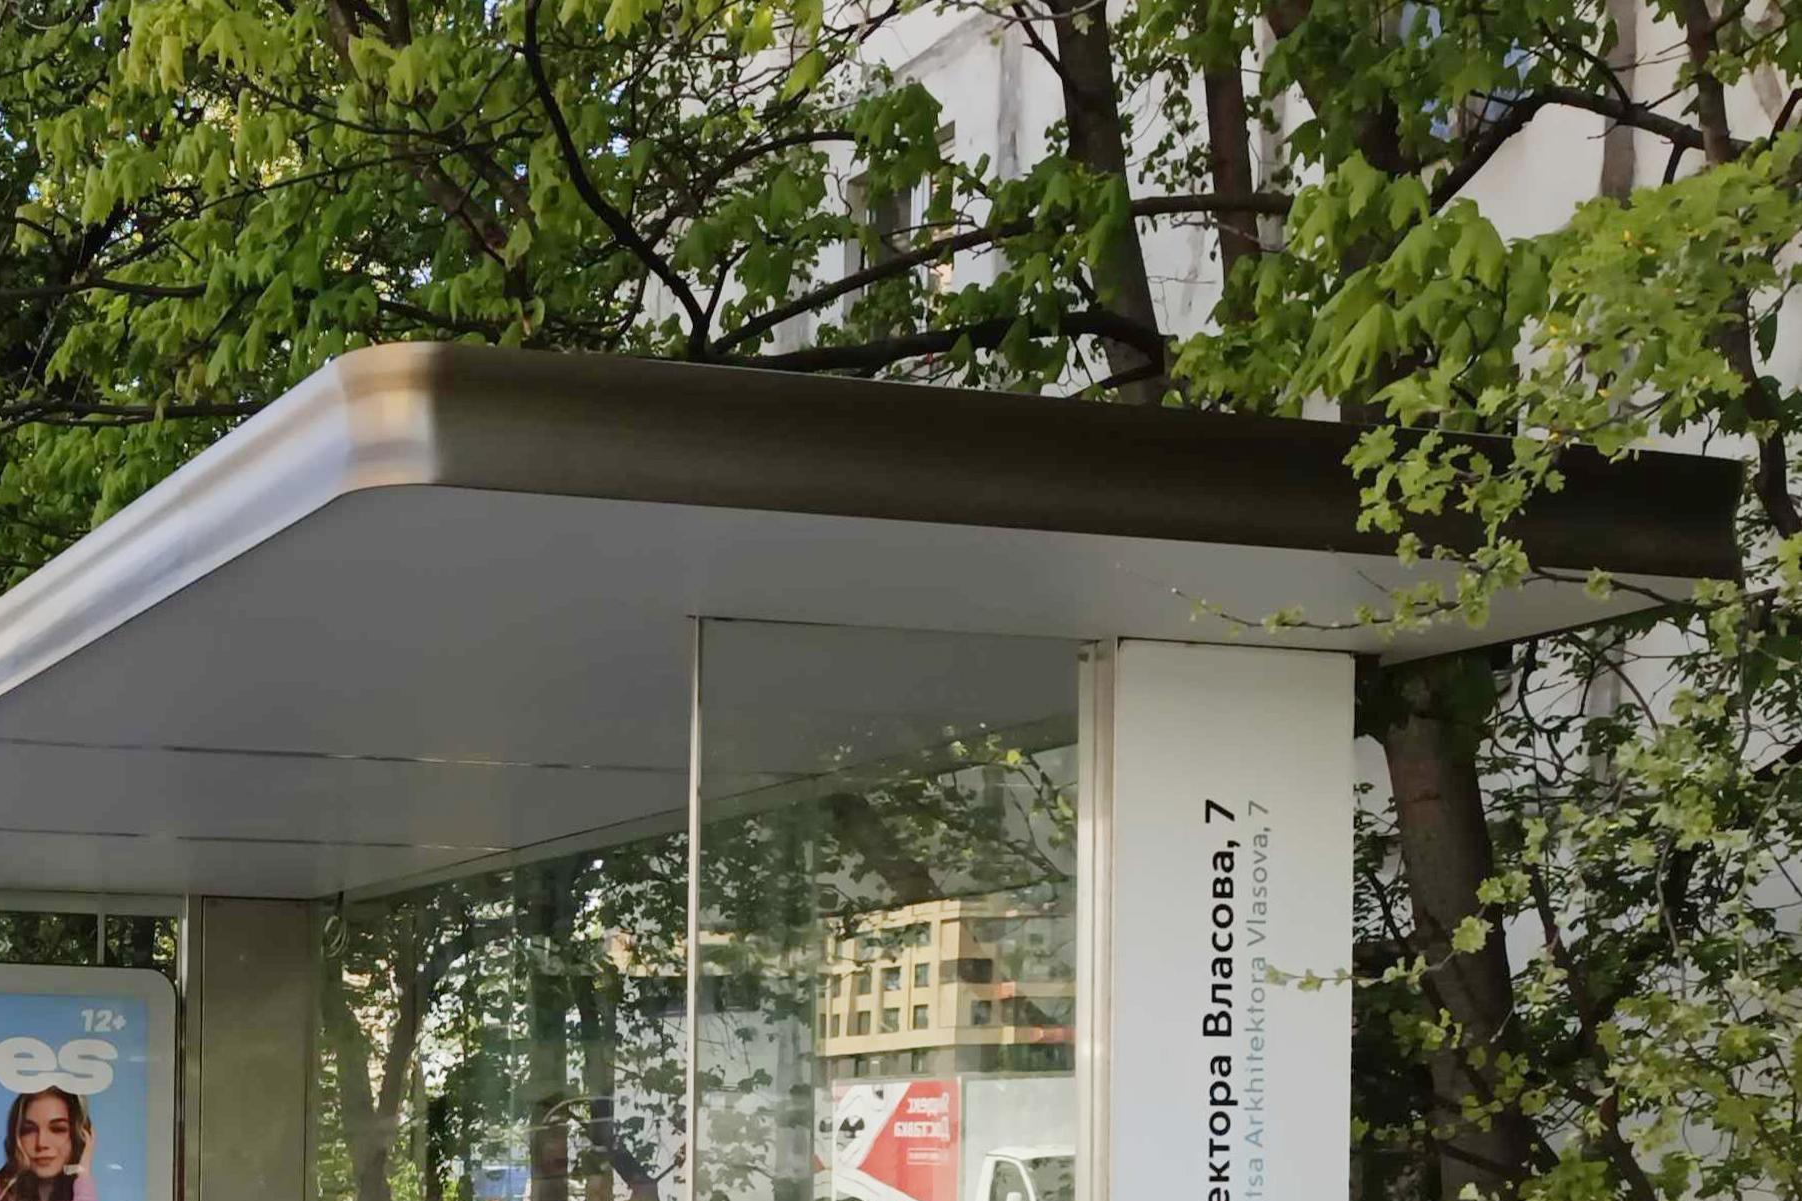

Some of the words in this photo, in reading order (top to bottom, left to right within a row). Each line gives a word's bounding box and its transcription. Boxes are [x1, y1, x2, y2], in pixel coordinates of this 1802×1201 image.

[1204, 798, 1235, 824] 7
[1247, 800, 1269, 815] 7
[1245, 826, 1272, 947] Vlasova,
[1203, 839, 1241, 1038] Власова,
[80, 1009, 127, 1033] 12+
[1243, 956, 1268, 1148] Arkhitektora
